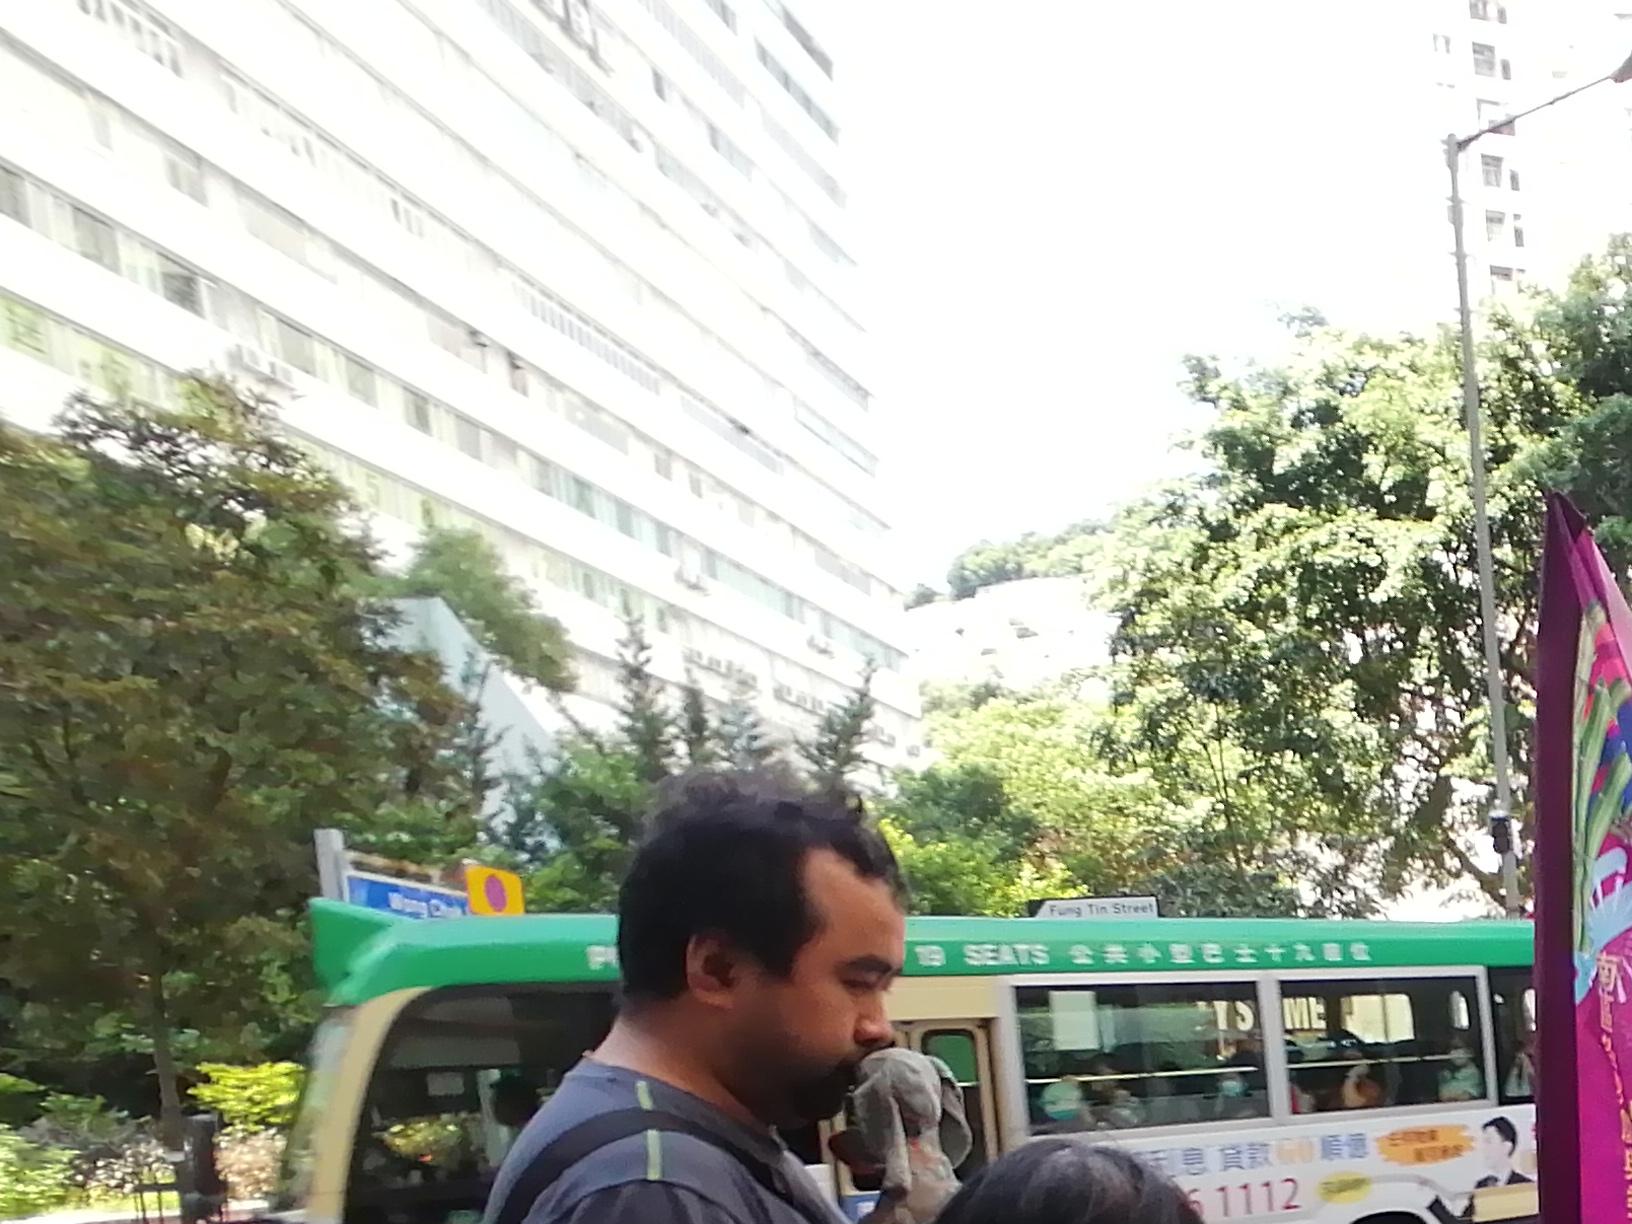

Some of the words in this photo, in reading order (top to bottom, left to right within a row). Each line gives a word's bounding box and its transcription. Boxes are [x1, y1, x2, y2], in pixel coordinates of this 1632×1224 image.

[1087, 903, 1108, 914] Tin
[1113, 902, 1153, 914] Street
[964, 943, 1049, 966] SEATS
[1216, 1177, 1302, 1218] 1112
